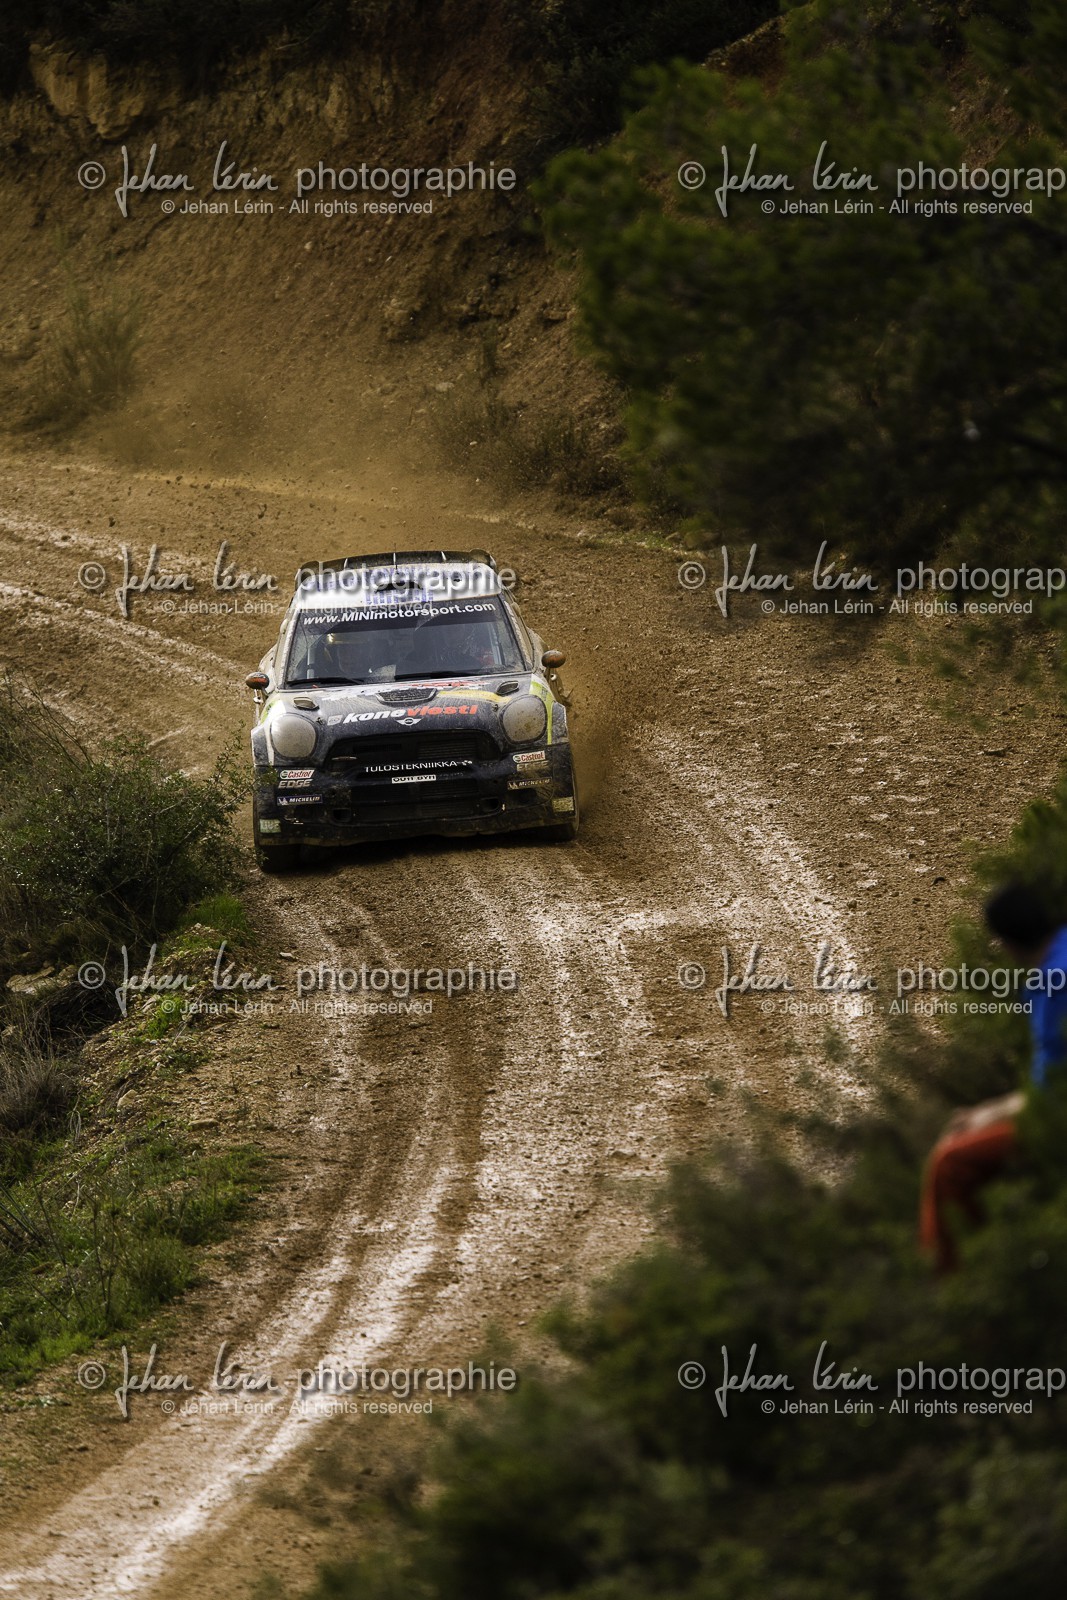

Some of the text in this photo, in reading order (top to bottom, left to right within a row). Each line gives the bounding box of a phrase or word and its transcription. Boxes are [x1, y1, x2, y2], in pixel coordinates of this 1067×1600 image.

[303, 602, 496, 625] www.MINImotorsport.com
[287, 770, 312, 778] Castrol
[278, 779, 313, 789] EDGE
